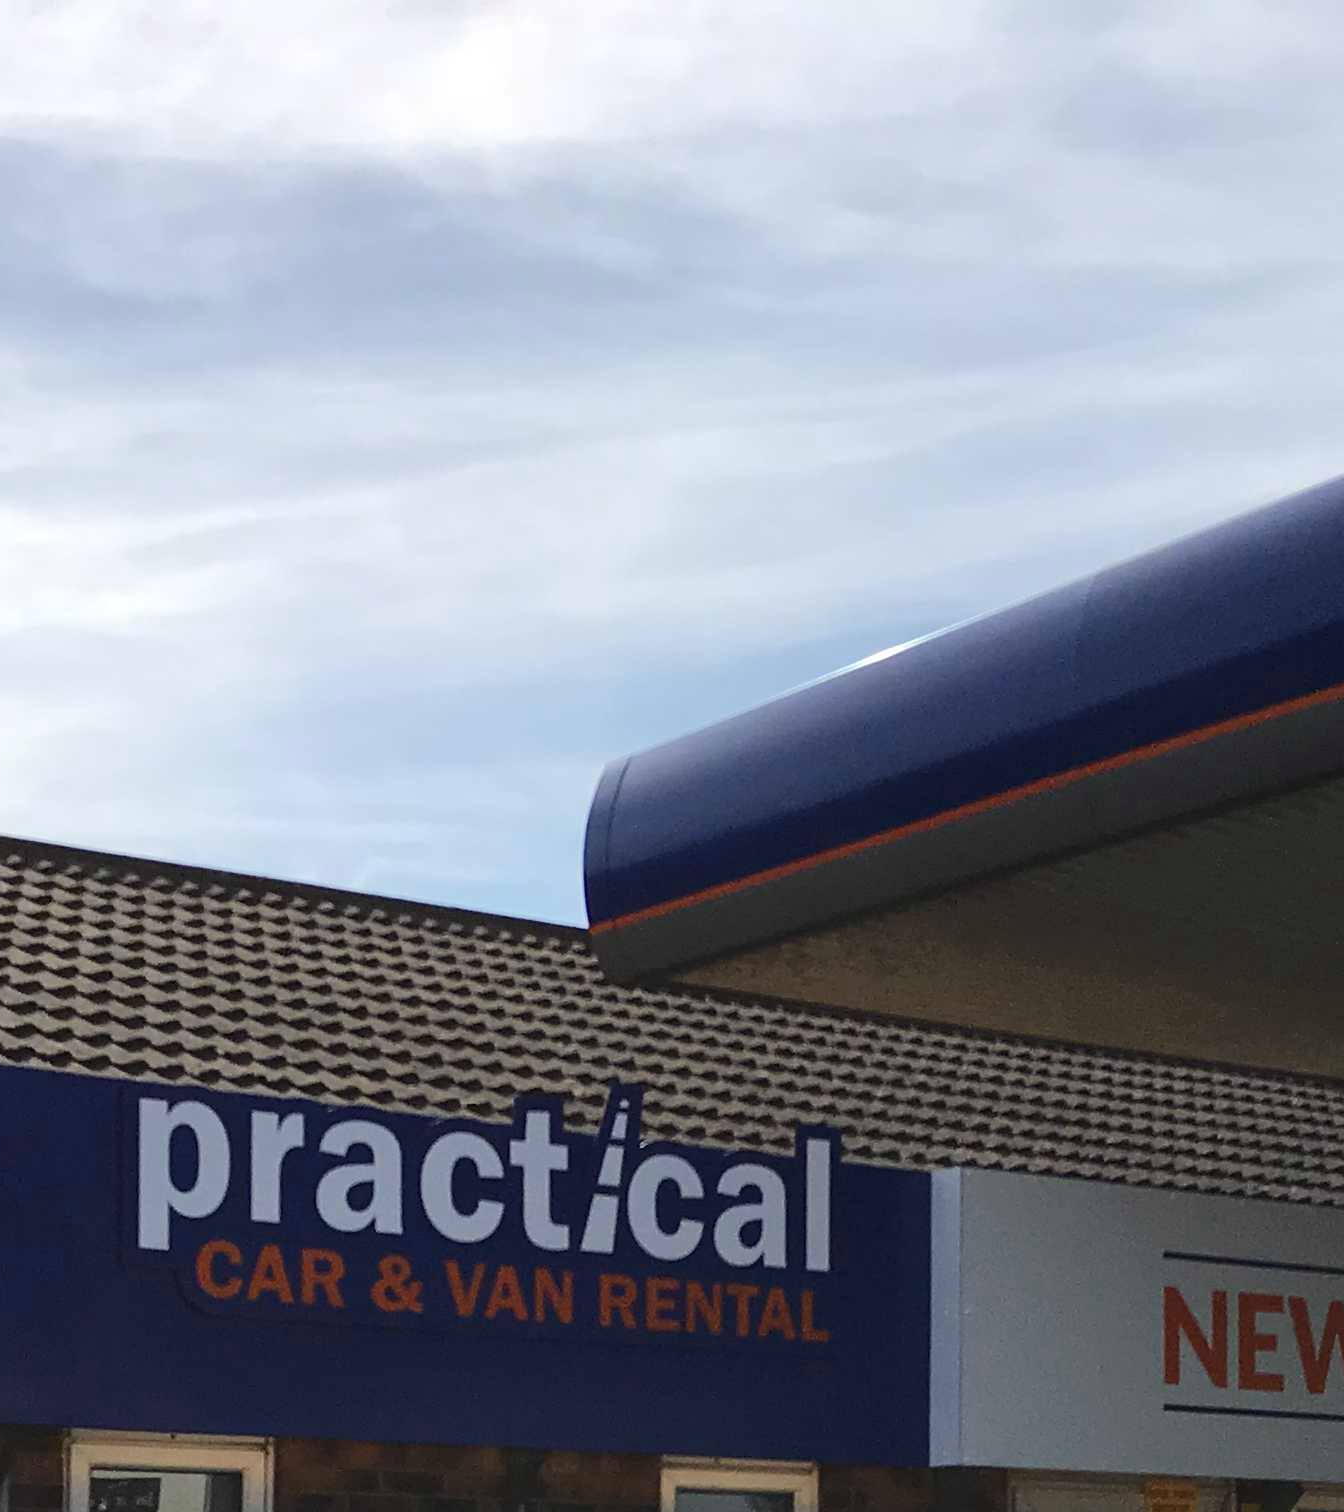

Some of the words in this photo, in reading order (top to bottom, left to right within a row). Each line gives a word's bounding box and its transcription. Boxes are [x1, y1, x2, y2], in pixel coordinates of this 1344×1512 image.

[137, 1095, 832, 1274] practical
[195, 1239, 346, 1309] CAR
[369, 1253, 425, 1315] &
[445, 1259, 575, 1326] VAN
[598, 1272, 831, 1344] RENTAL
